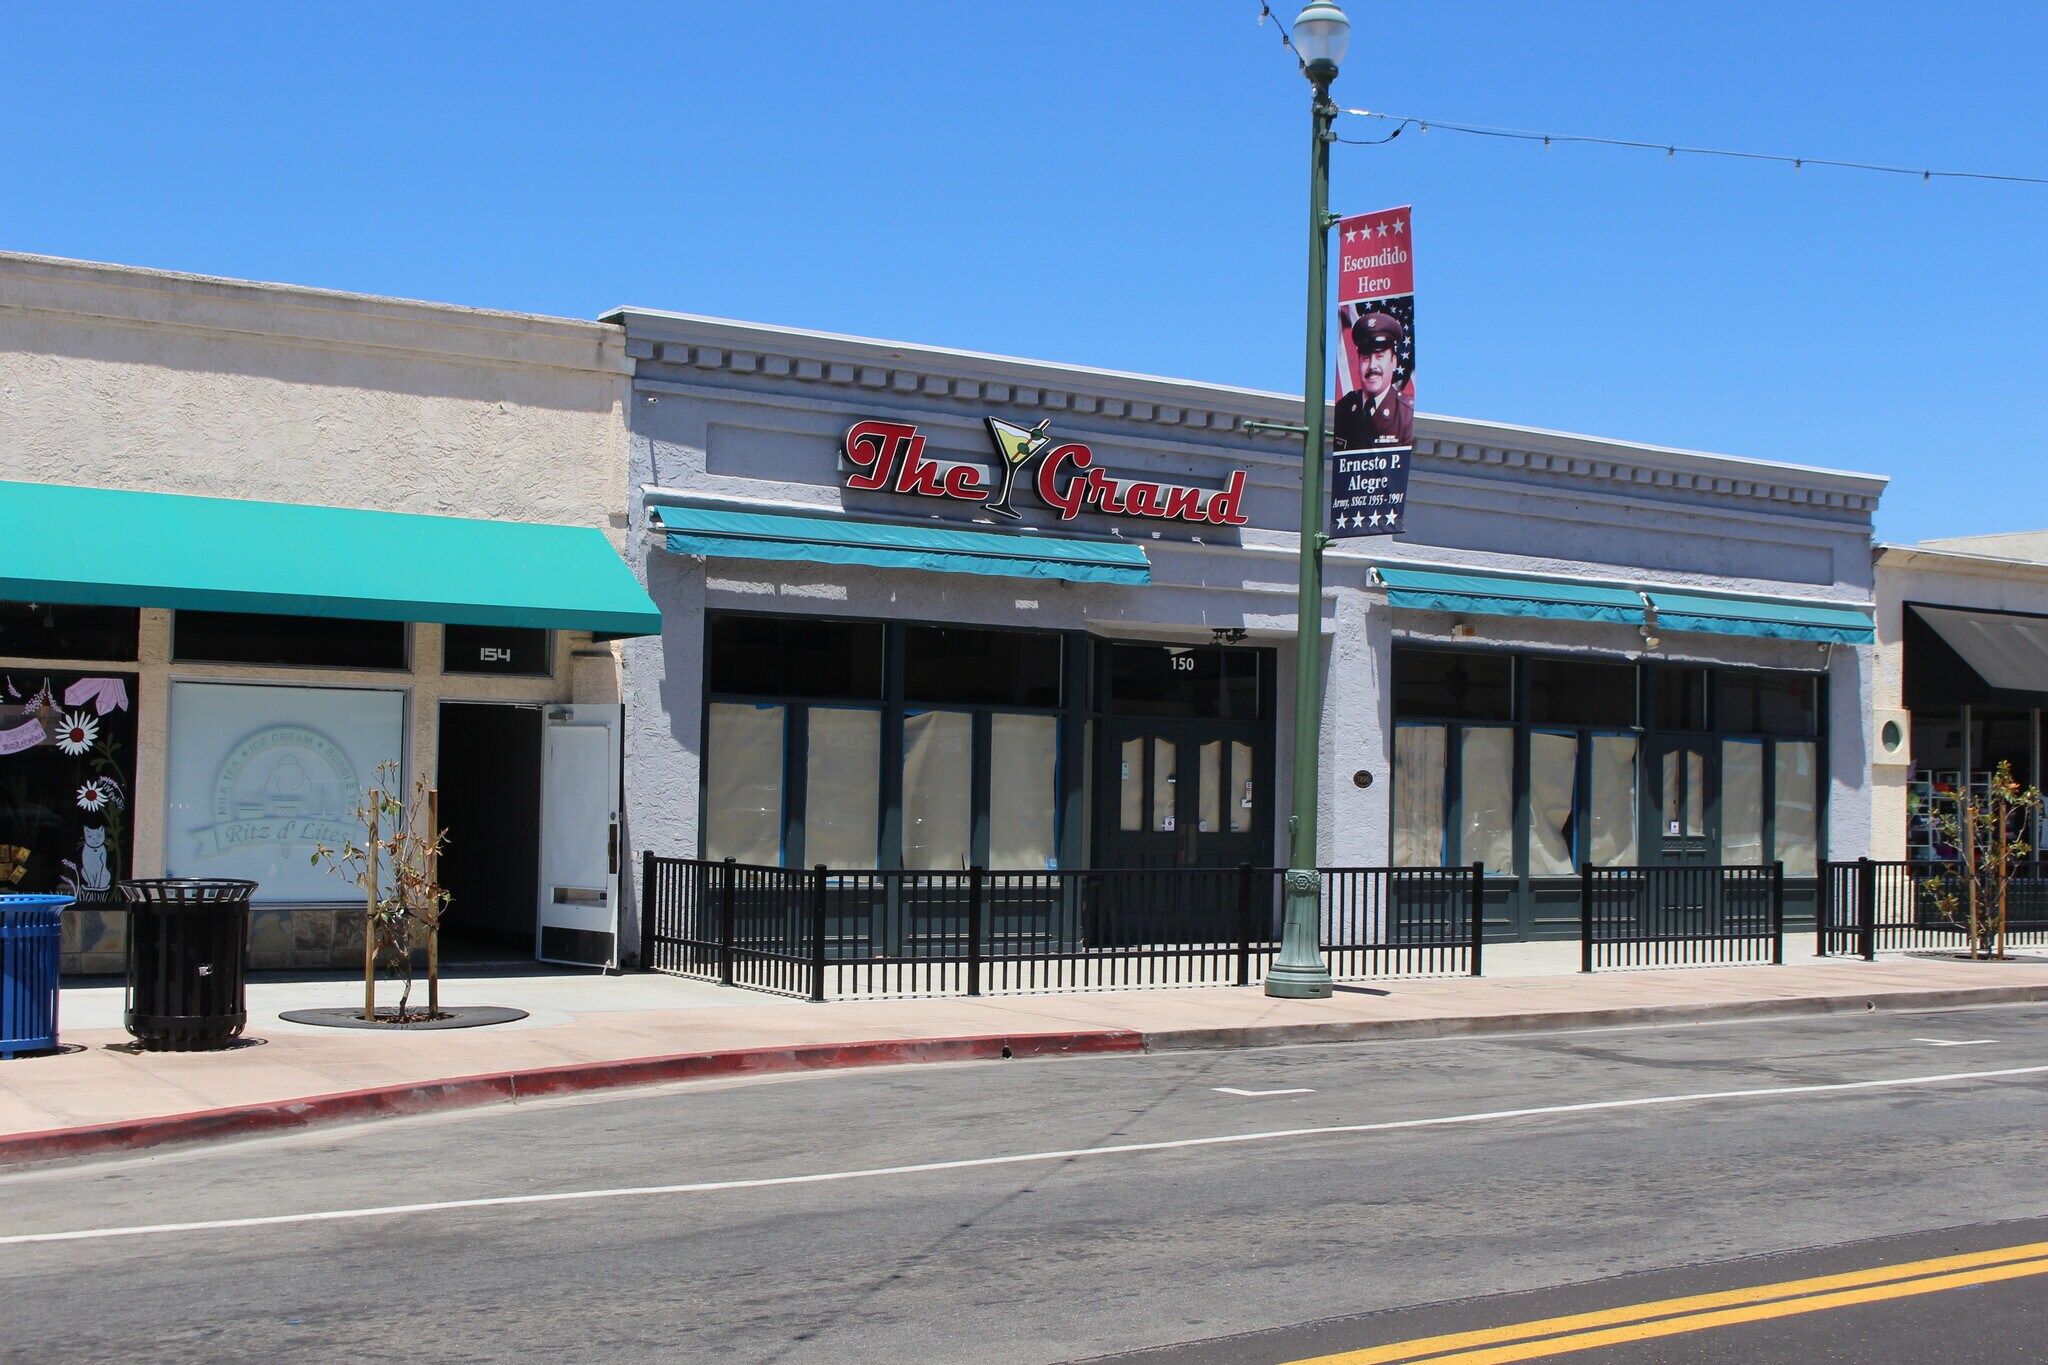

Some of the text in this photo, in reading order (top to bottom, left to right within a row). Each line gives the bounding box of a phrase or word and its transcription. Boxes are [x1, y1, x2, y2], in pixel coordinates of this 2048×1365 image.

[1343, 246, 1407, 272] Escondido
[1358, 276, 1391, 293] Hero
[845, 420, 1249, 525] The Grand
[1339, 454, 1401, 473] Ernesto P.
[1348, 474, 1388, 493] Alegre
[1333, 498, 1350, 510] Army,
[1368, 494, 1384, 506] 1955
[1388, 493, 1404, 505] 1991
[480, 647, 510, 661] 154
[1171, 657, 1194, 670] 150
[248, 737, 267, 752] ICE
[271, 732, 314, 744] CREAM
[222, 760, 239, 782] TEA
[218, 786, 229, 815] MILK
[226, 822, 270, 843] Ritz
[300, 823, 350, 844] Lites
